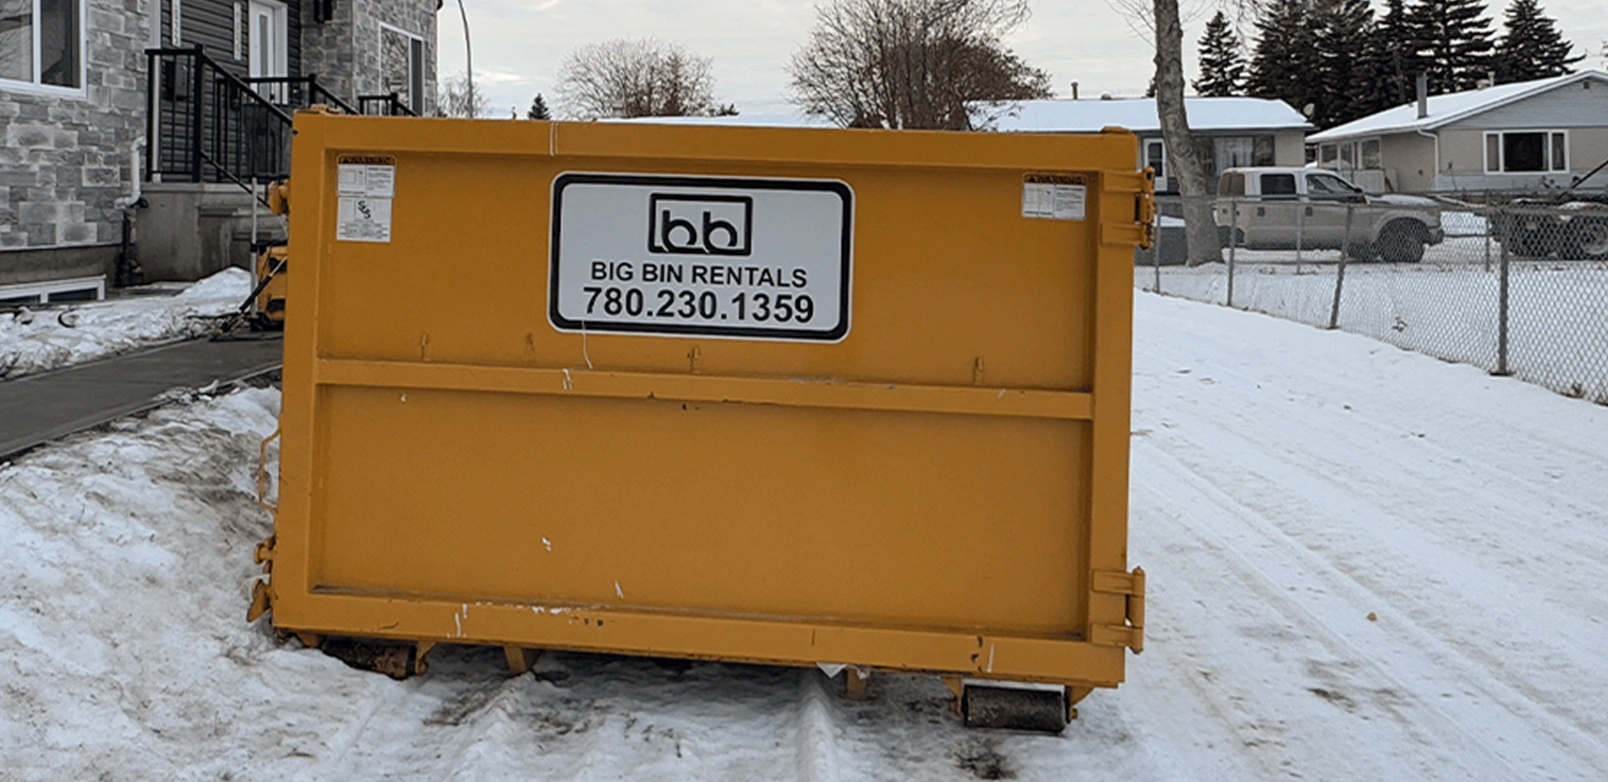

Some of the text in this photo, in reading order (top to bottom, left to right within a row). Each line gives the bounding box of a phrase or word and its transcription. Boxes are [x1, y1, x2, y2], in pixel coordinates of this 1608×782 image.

[591, 261, 807, 289] BIG BIN RENTALS
[583, 286, 814, 323] 780.230.1359
